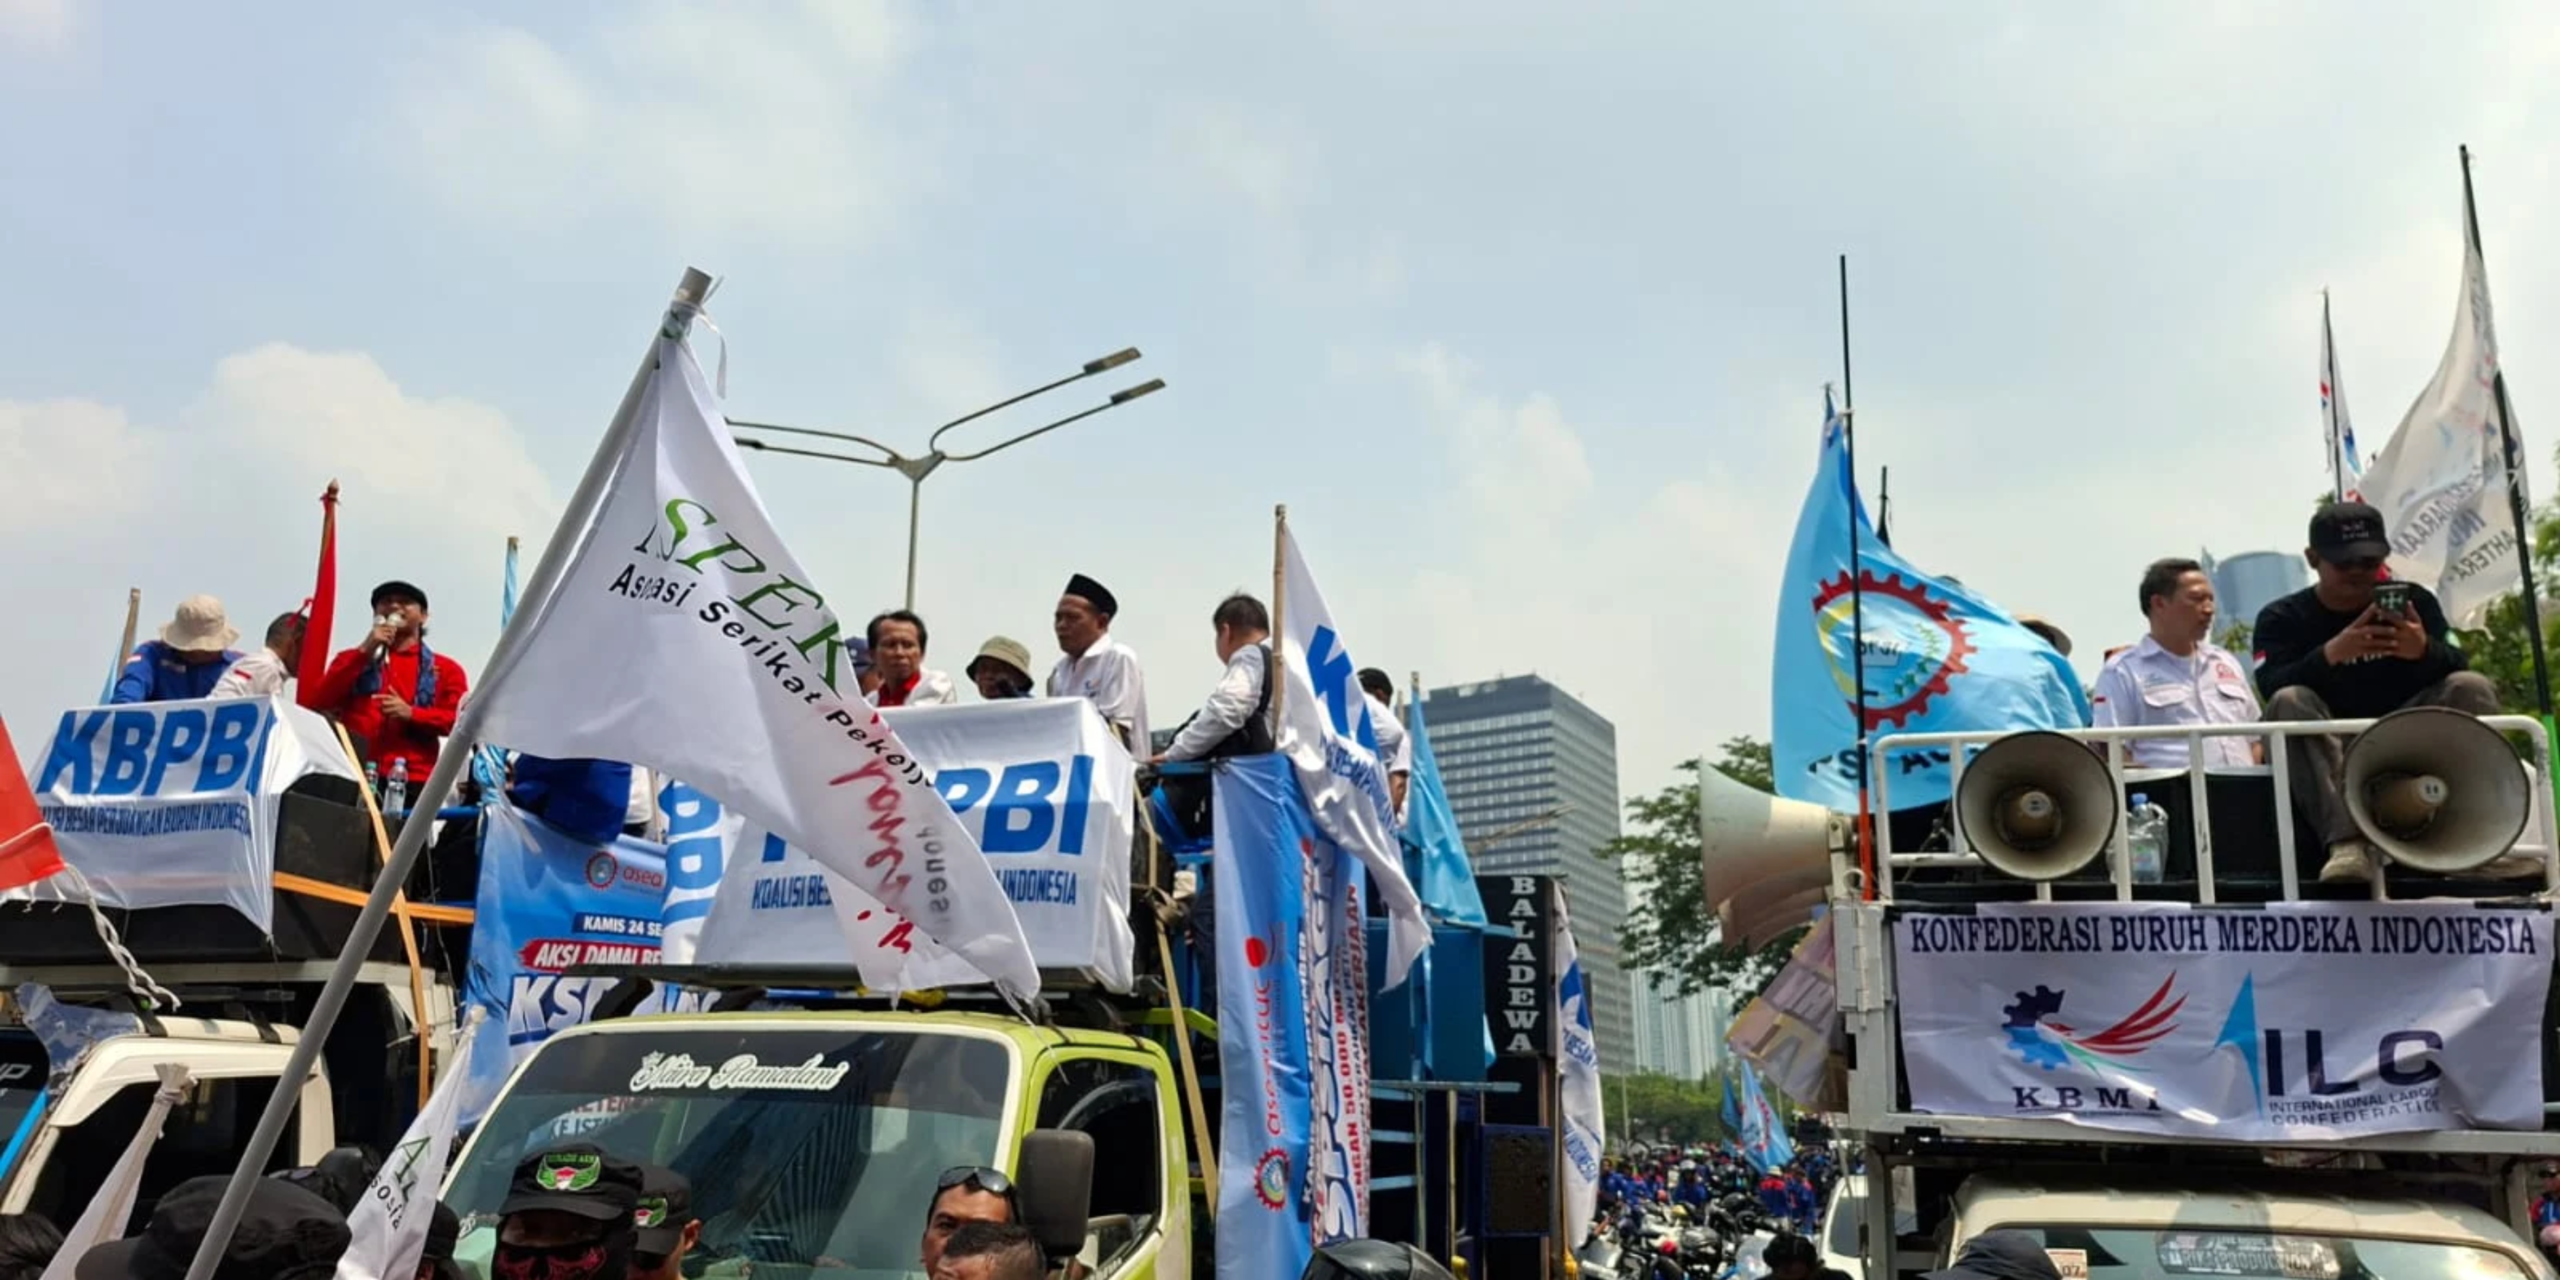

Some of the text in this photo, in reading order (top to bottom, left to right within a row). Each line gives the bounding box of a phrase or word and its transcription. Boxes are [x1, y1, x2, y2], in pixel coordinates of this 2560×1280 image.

[700, 601, 822, 704] Serikat
[752, 876, 806, 909] KOALISI
[583, 914, 626, 933] KAMIS
[628, 919, 645, 936] 24
[1910, 916, 2537, 954] KONFEDERASI BURUH MERDEKA INDONESIA
[533, 943, 581, 967] AKSI
[1503, 876, 1540, 1052] BALADEWA
[2269, 1095, 2387, 1114] INTERNATIONAL
